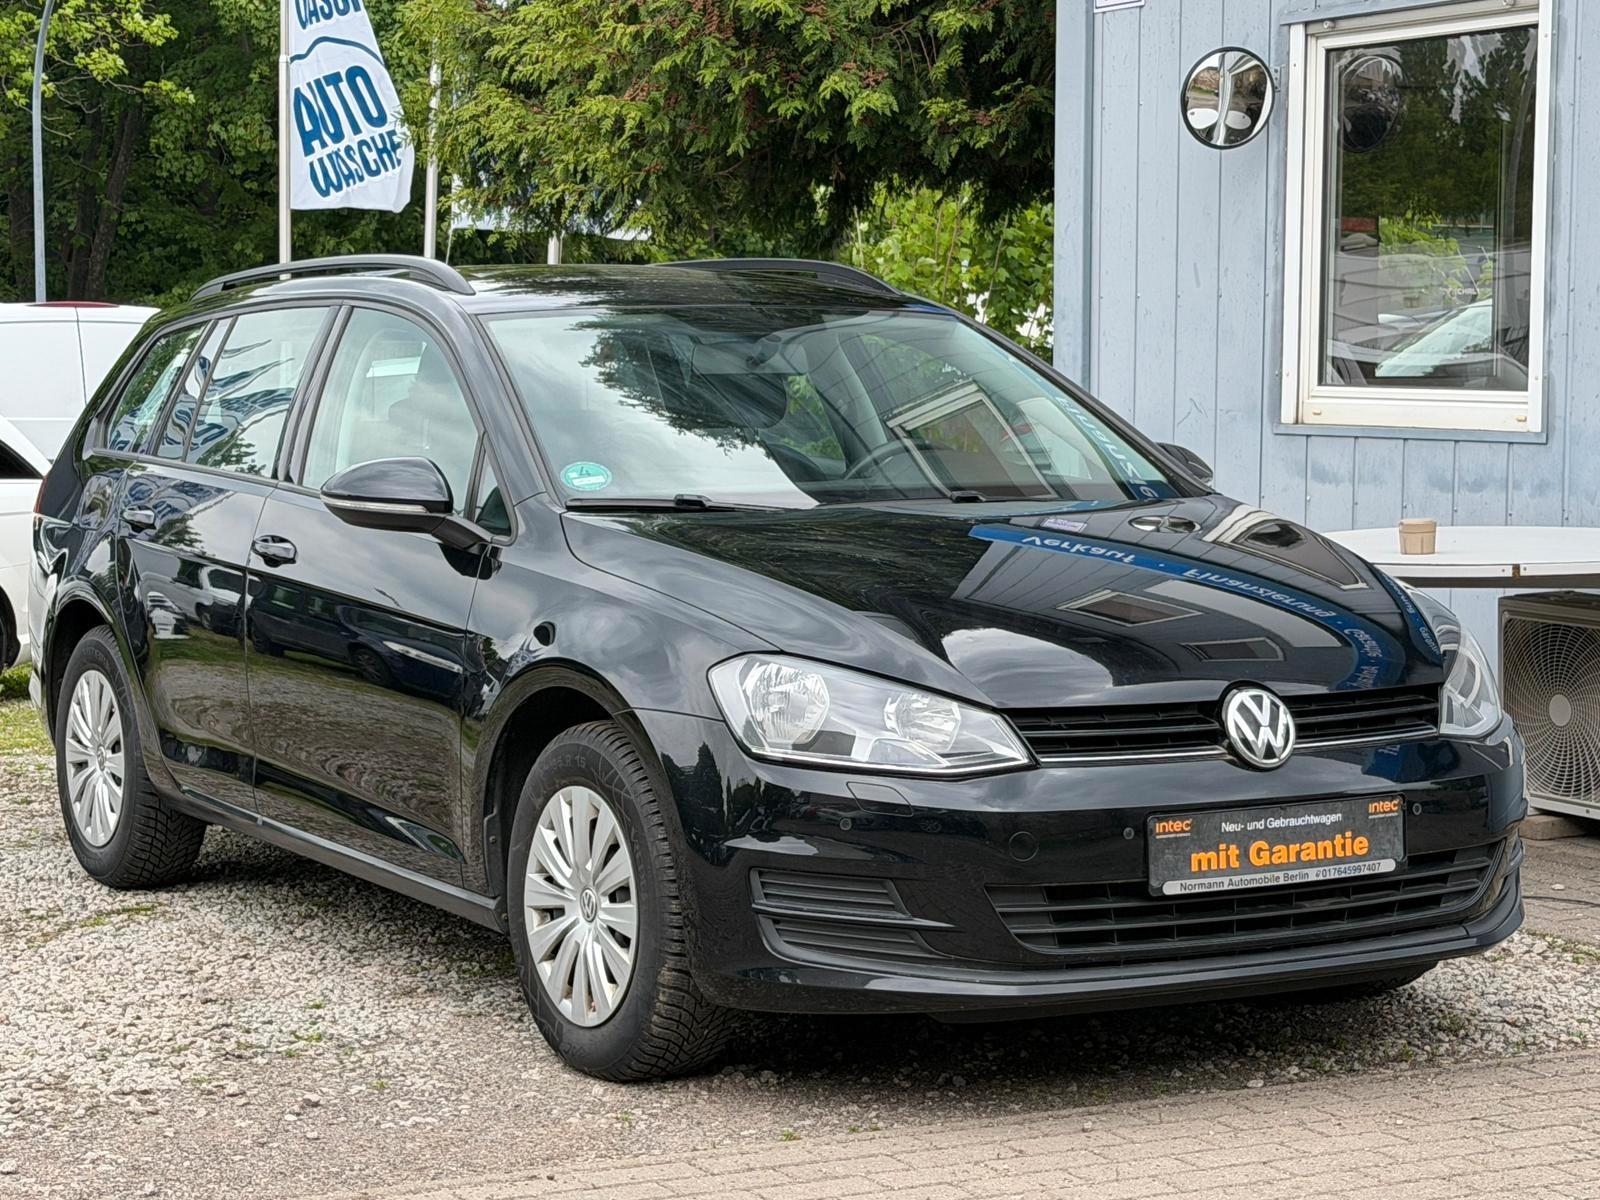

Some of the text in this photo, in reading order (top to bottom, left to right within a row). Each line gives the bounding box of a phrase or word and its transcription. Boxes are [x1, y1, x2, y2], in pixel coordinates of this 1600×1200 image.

[293, 65, 388, 157] AUTO
[1221, 813, 1342, 832] Neu- und Gebrauchtwagen
[1190, 831, 1369, 872] mit Garantie
[1180, 881, 1225, 892] Normann
[1227, 874, 1281, 888] Automobile
[1283, 871, 1309, 882] Berlin
